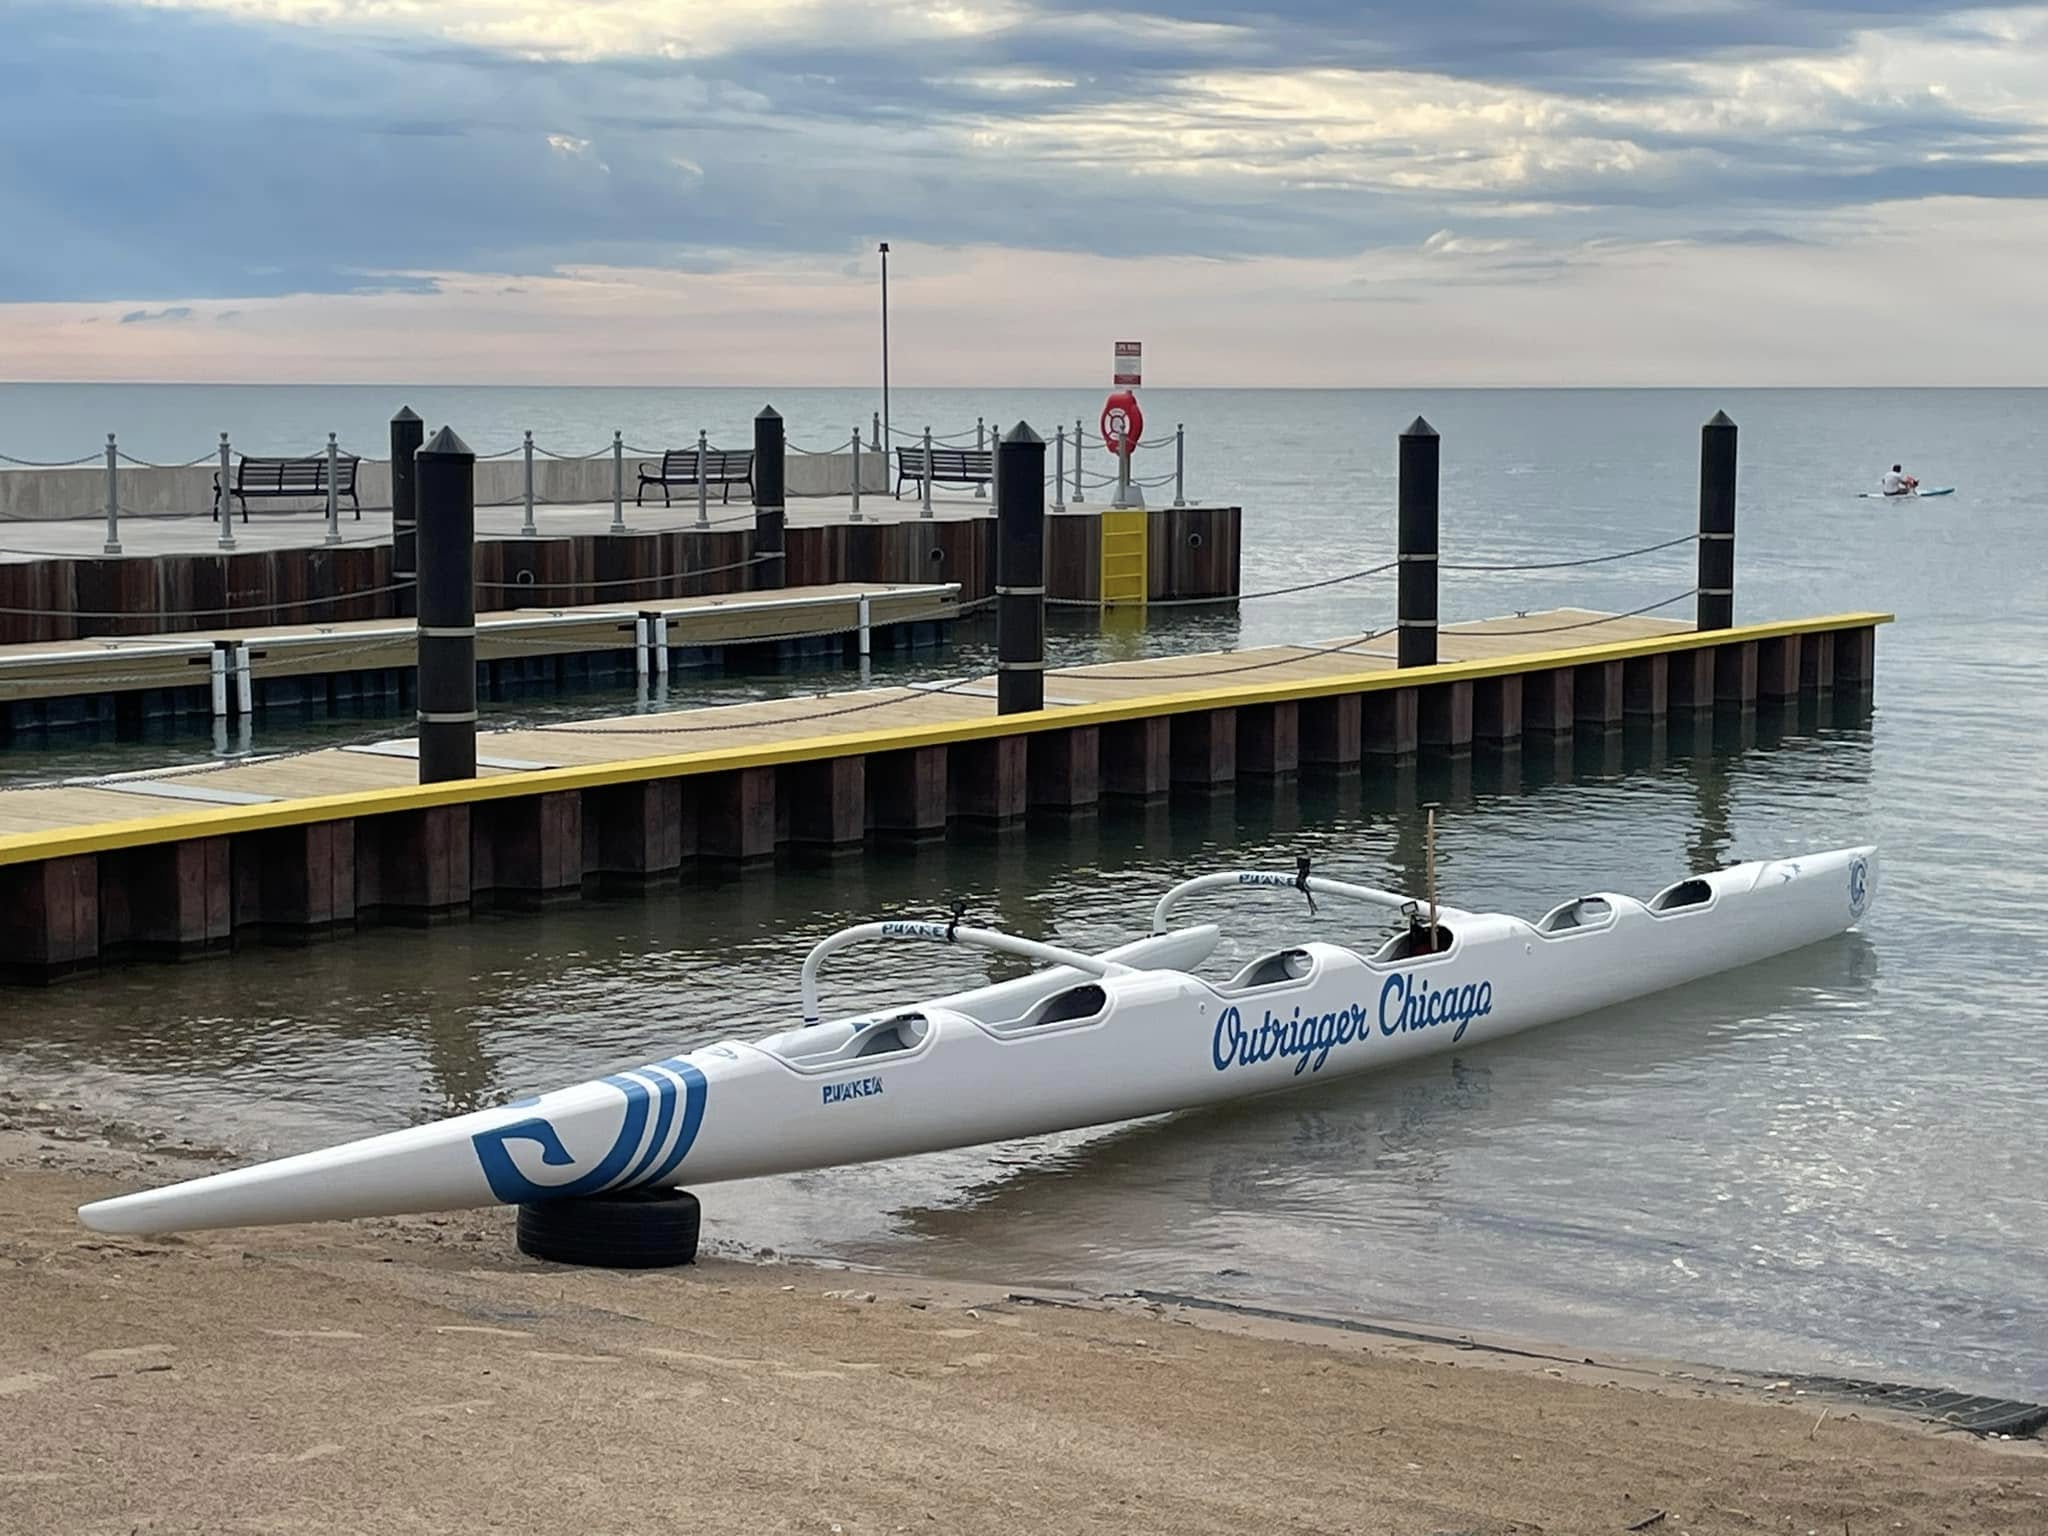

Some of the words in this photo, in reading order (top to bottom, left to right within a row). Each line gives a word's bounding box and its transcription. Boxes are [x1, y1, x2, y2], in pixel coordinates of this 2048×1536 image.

[882, 923, 949, 937] PUAKE
[1213, 1003, 1369, 1076] Outrigger
[1379, 973, 1492, 1042] Chicago
[823, 1077, 883, 1104] PUAKEA
